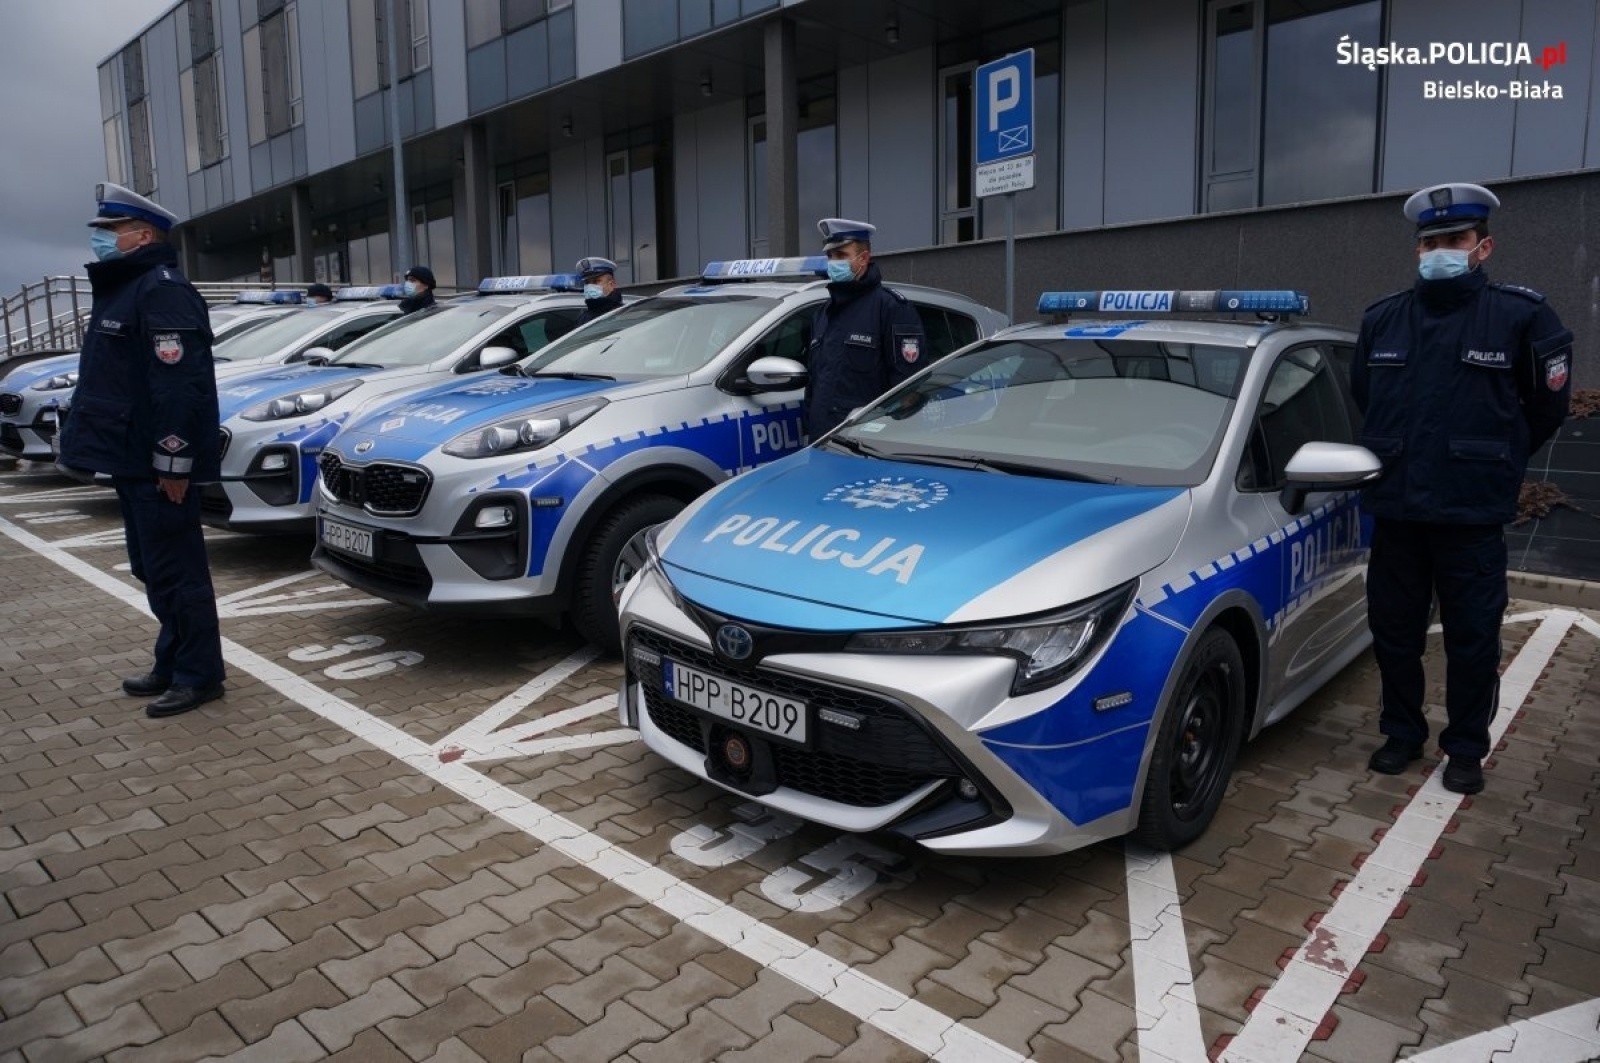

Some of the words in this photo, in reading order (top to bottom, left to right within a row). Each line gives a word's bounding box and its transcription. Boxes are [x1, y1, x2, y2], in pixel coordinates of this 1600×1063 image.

[989, 64, 1020, 132] P
[731, 260, 775, 275] POLICJA
[1103, 292, 1169, 310] POLICJA
[1467, 350, 1505, 362] POLICJA
[752, 416, 809, 454] POLI
[345, 529, 370, 554] B207
[702, 514, 925, 585] POLICJA
[1291, 505, 1361, 593] POLICJA
[287, 634, 425, 680] 36
[677, 667, 721, 709] HPP
[731, 686, 798, 735] B209
